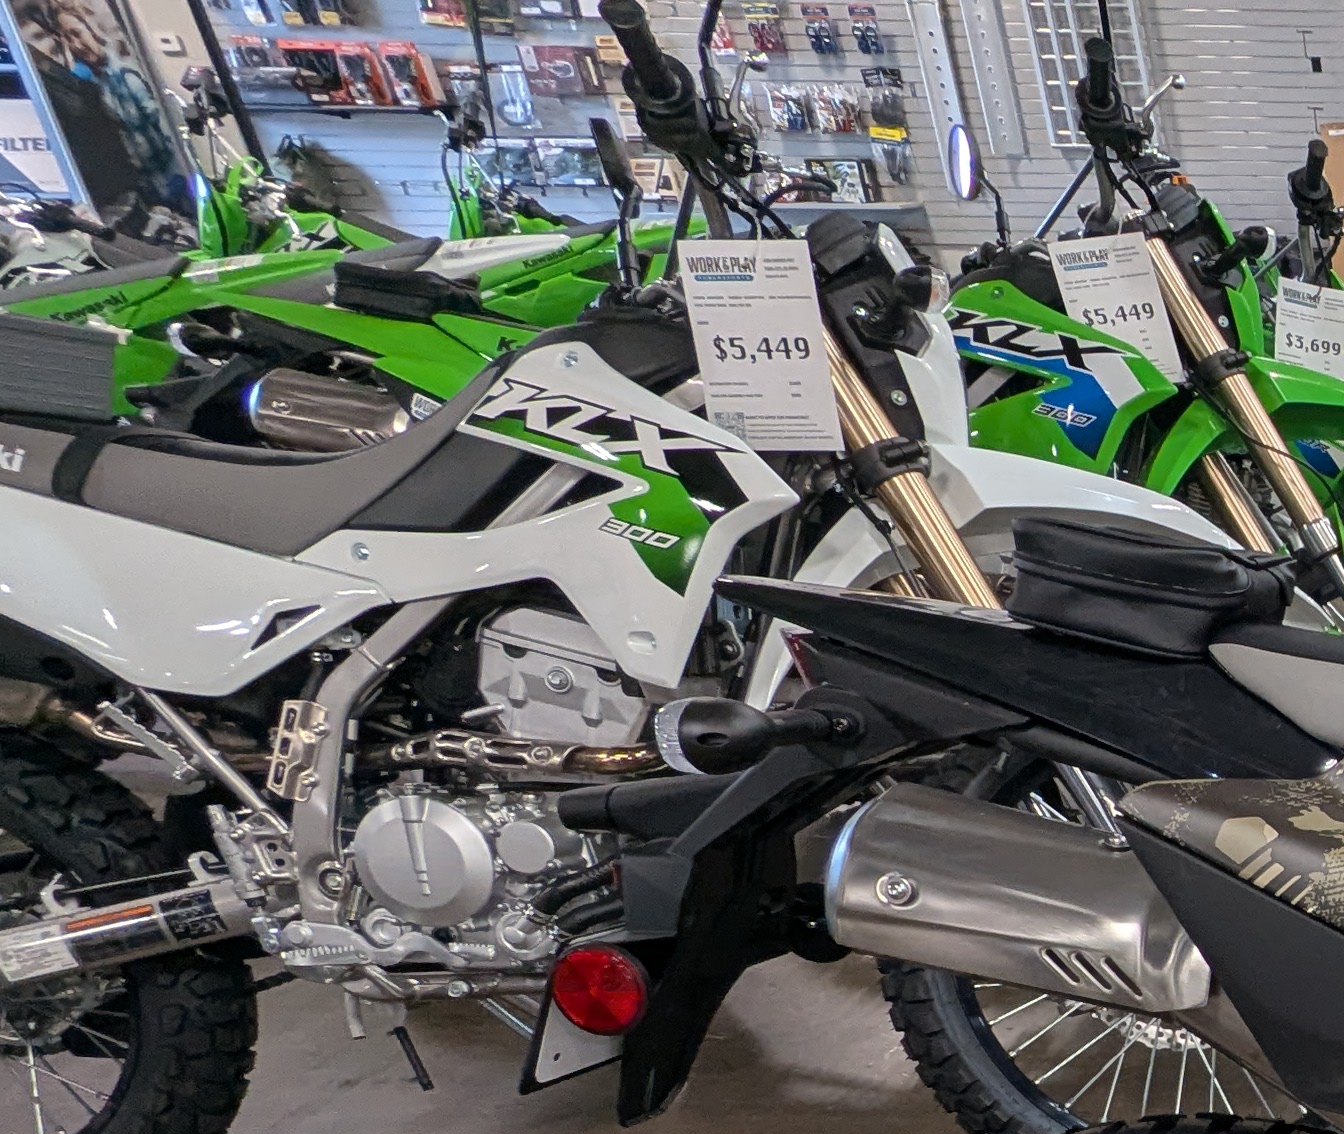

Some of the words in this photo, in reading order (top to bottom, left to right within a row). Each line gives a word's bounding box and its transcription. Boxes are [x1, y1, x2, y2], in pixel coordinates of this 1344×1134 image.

[0, 137, 51, 151] ILTE
[1082, 302, 1155, 327] $5,449
[713, 334, 811, 364] $5,449
[1285, 332, 1341, 356] $3,699
[463, 378, 747, 476] KLX
[1031, 402, 1097, 428] 300
[599, 517, 682, 549] 300
